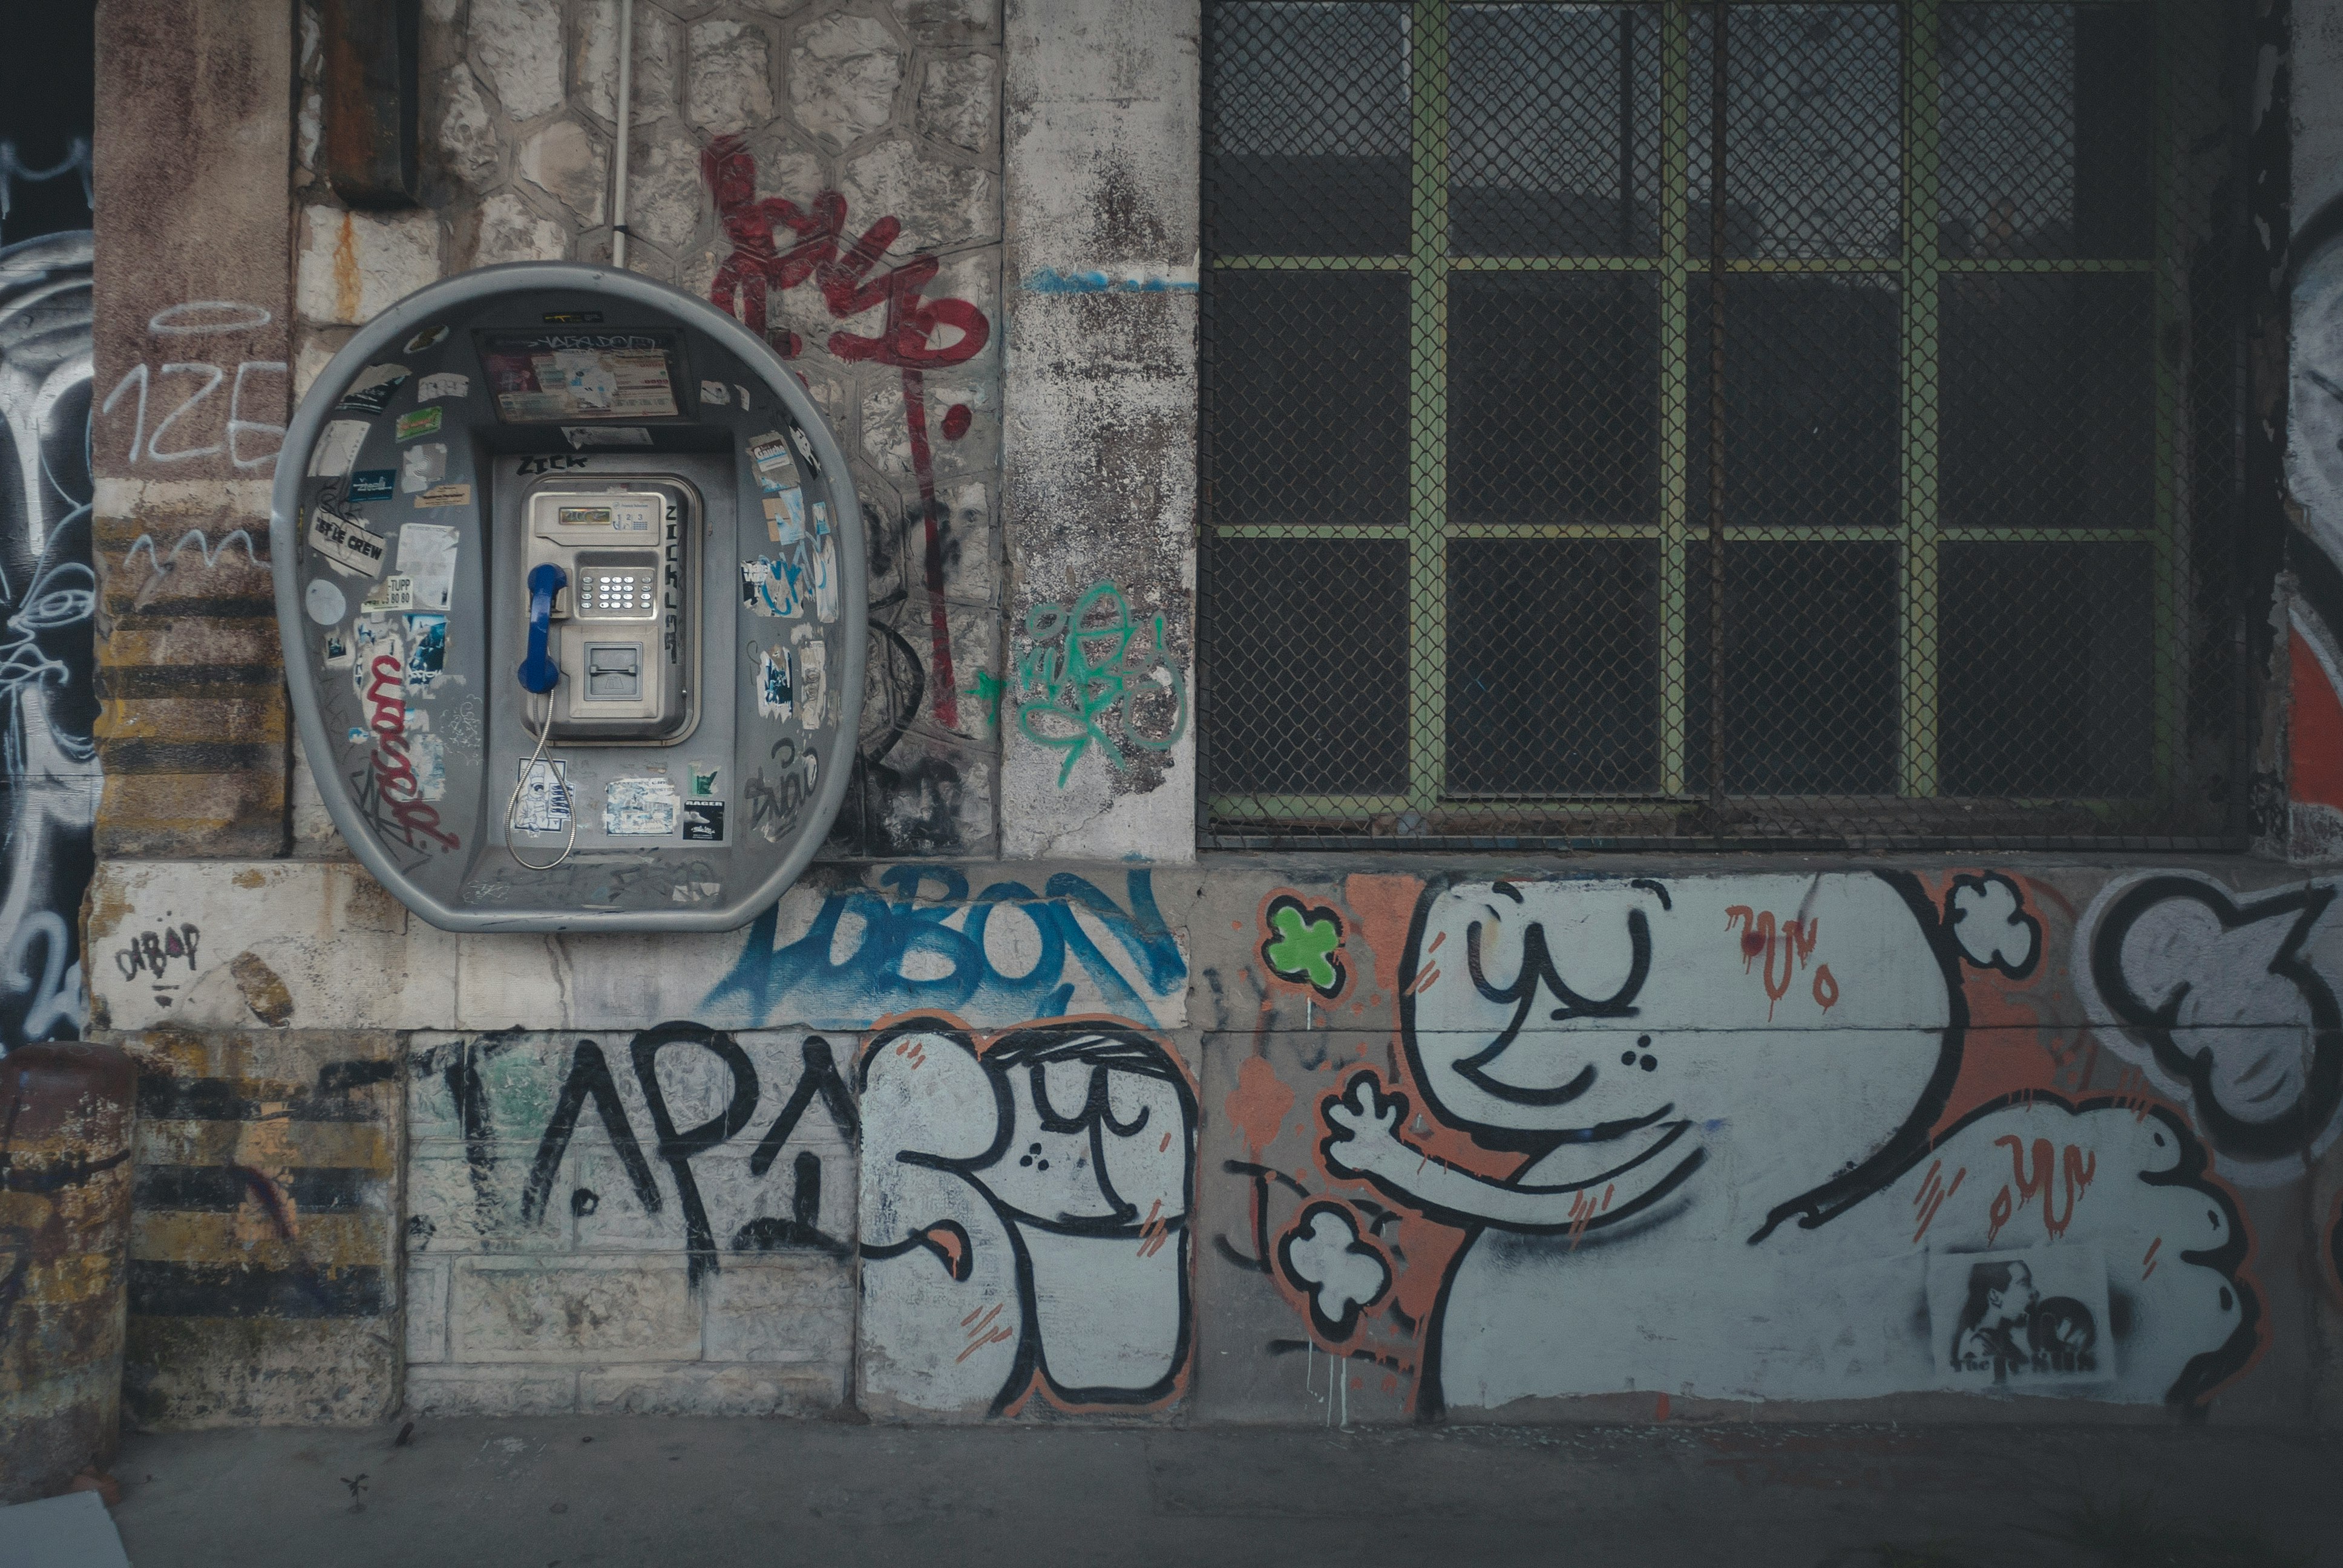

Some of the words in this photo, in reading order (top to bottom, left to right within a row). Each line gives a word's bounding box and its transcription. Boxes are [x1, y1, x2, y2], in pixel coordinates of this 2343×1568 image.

[516, 454, 588, 476] ZICK
[348, 535, 382, 560] CREW
[391, 593, 399, 604] 80
[401, 593, 410, 604] 80
